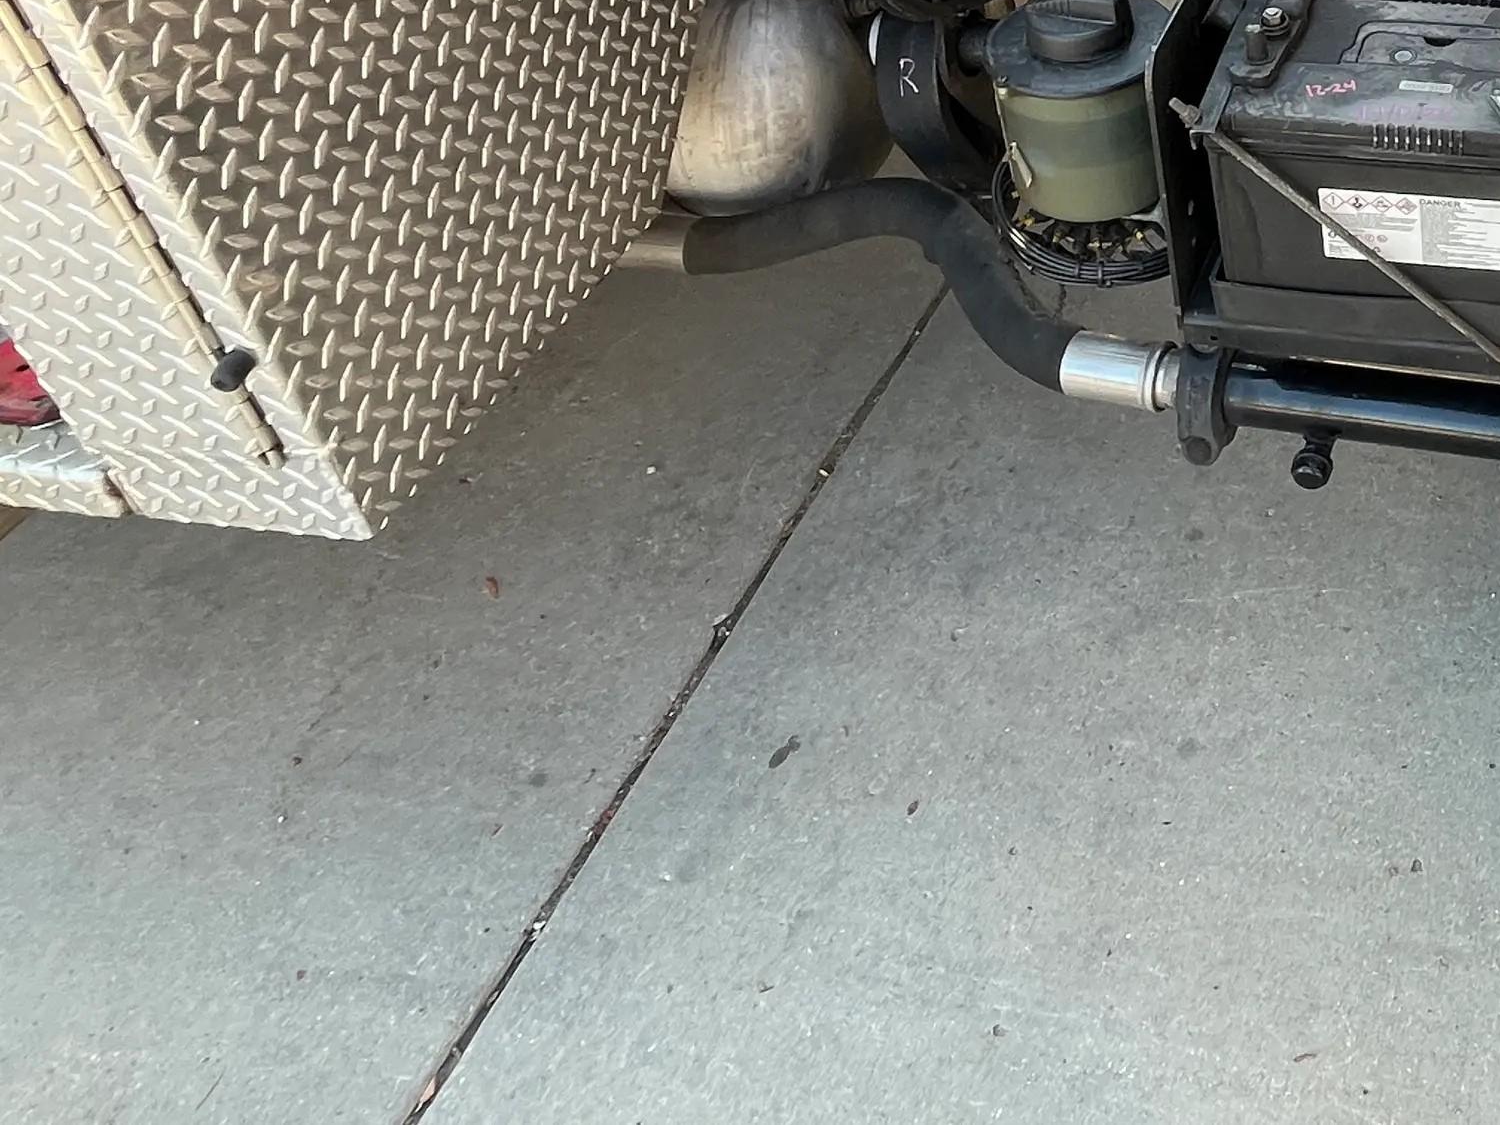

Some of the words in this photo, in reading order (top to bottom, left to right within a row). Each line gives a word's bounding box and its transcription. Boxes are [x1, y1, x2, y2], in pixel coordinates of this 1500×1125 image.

[898, 57, 920, 98] R
[1305, 79, 1357, 98] 12-24
[1418, 198, 1462, 208] DANGER
